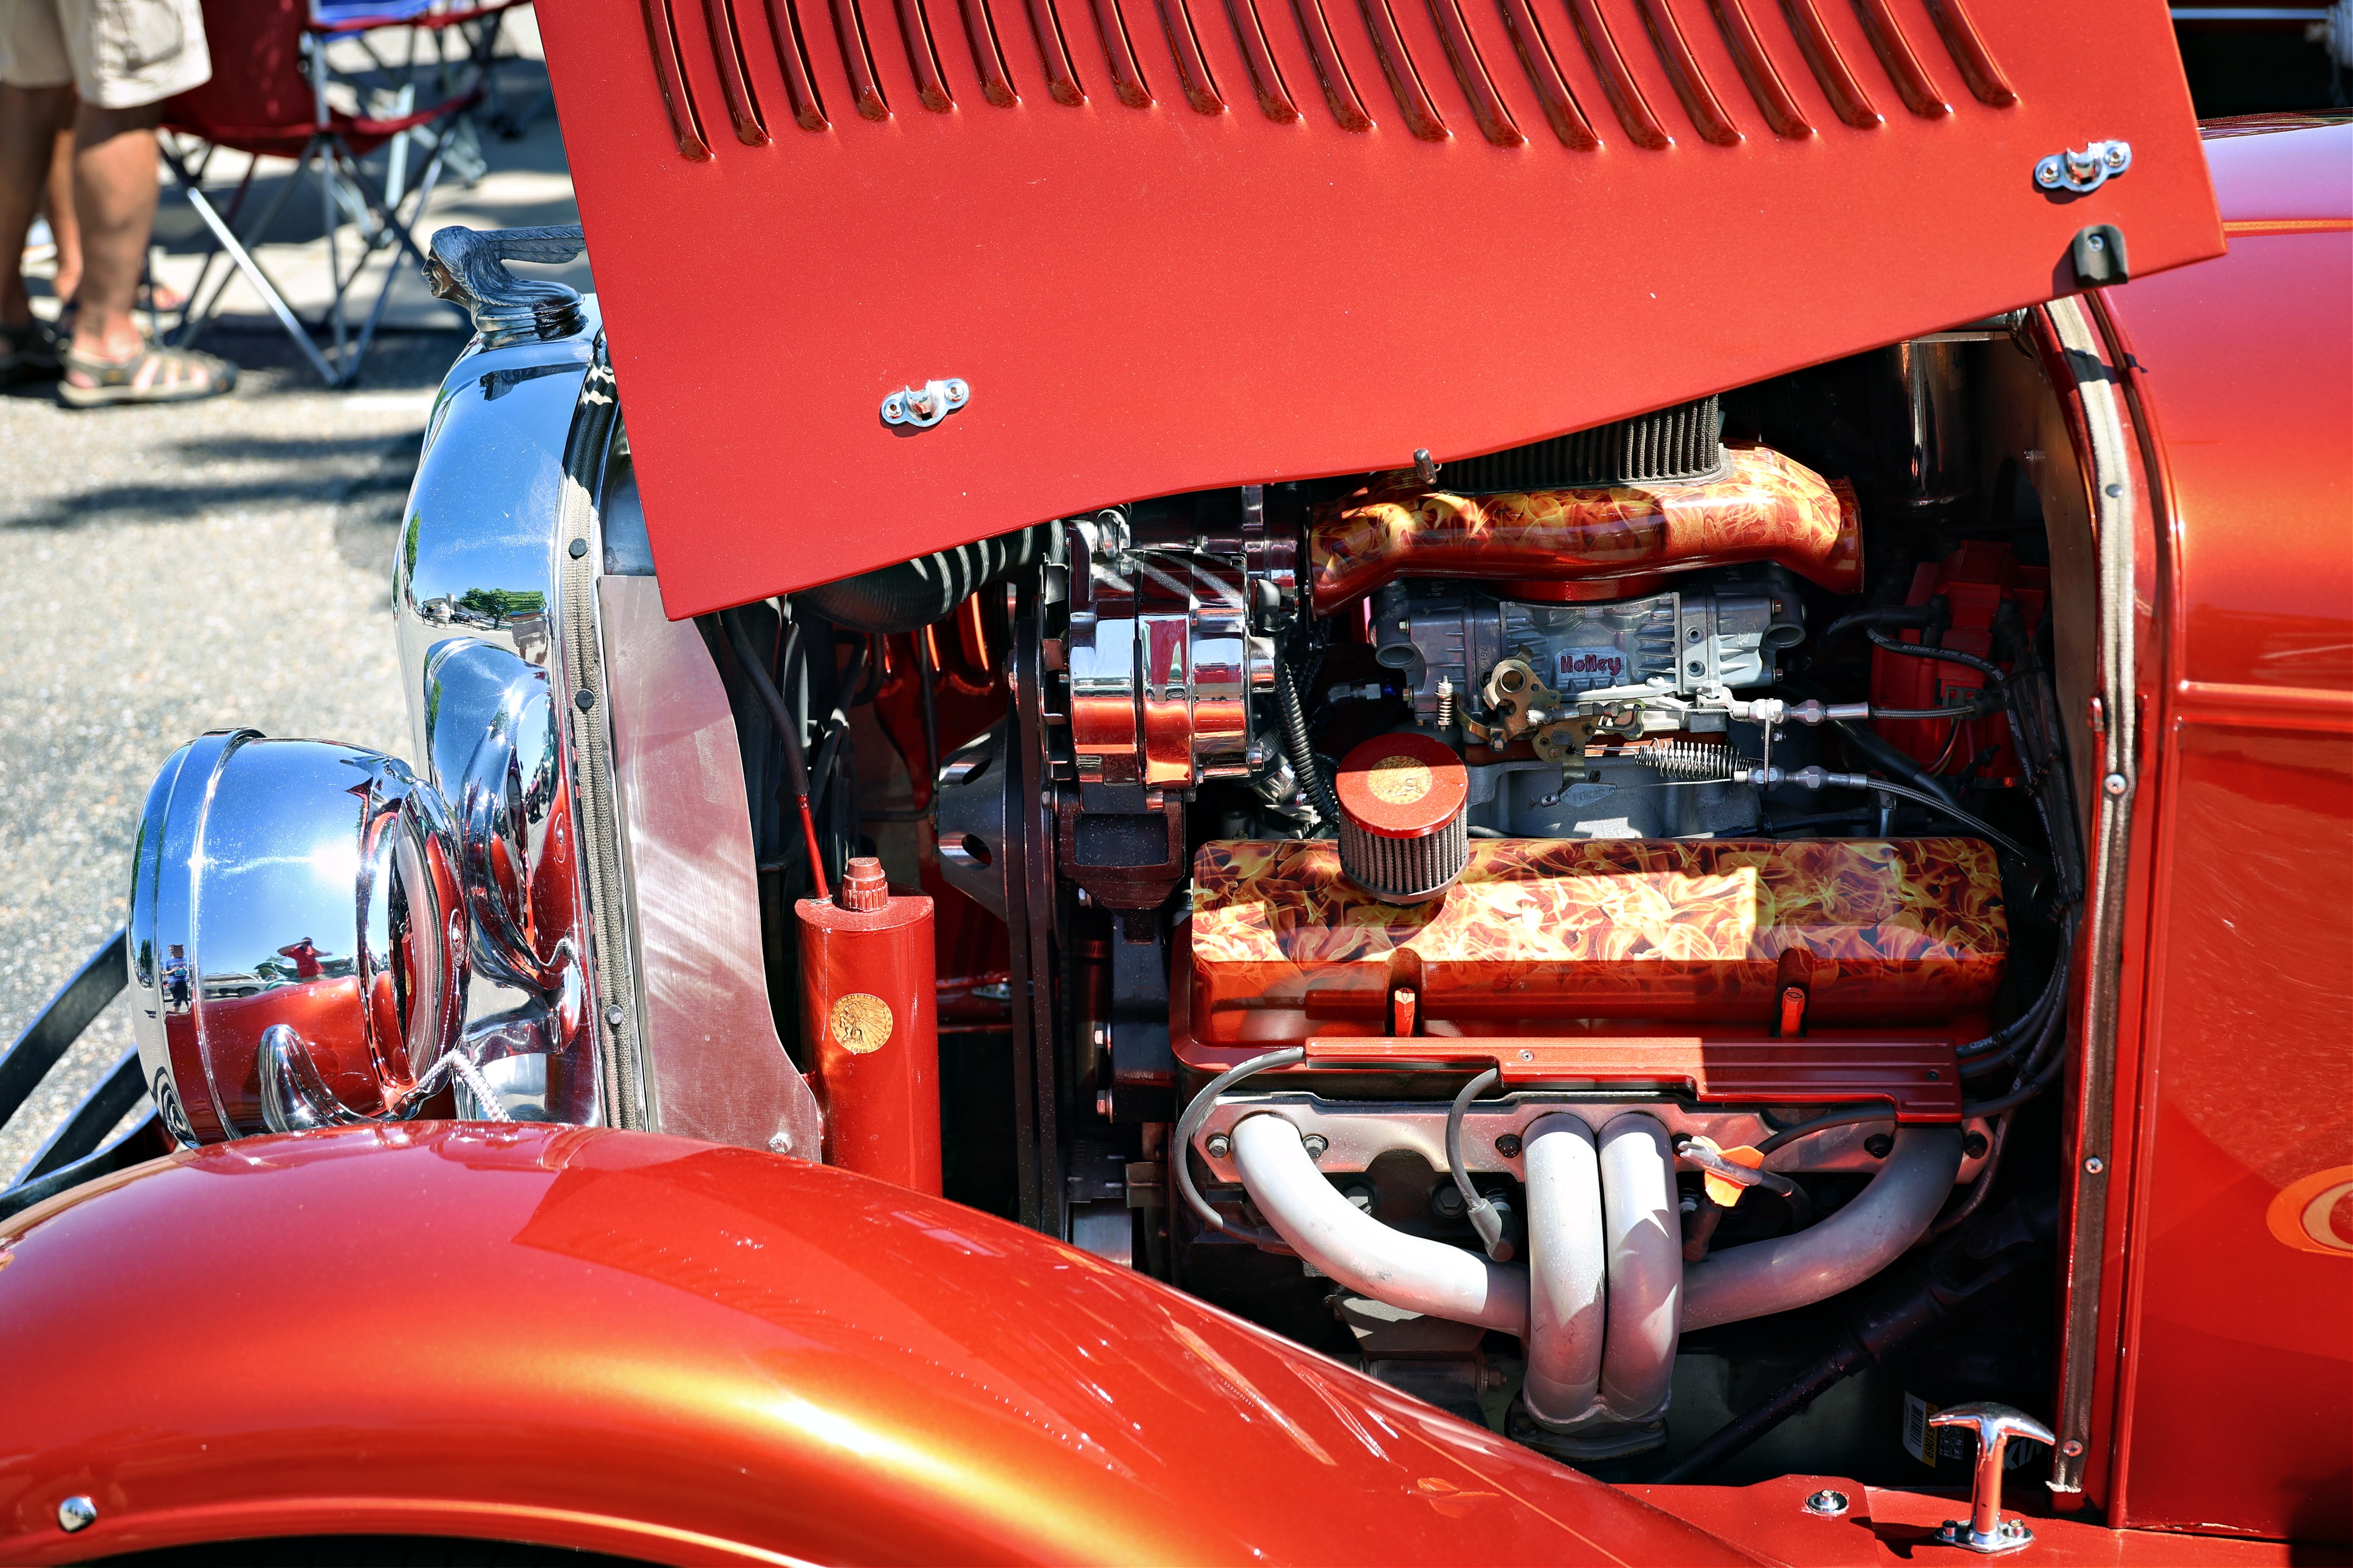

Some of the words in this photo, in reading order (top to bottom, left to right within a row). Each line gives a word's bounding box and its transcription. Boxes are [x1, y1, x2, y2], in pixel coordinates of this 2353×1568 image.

[1560, 654, 1621, 676] Holley
[1902, 644, 1937, 653] STREET
[1939, 648, 1959, 657] FIRE
[1960, 652, 1983, 663] WIRE
[1982, 660, 1994, 669] BY
[1992, 668, 2007, 682] MS
[1573, 787, 1605, 801] LOKAR
[840, 995, 878, 1004] LIBERTY
[1969, 1036, 1993, 1049] MSD
[2035, 1028, 2048, 1052] WIRE
[1925, 1426, 1936, 1459] 51069
